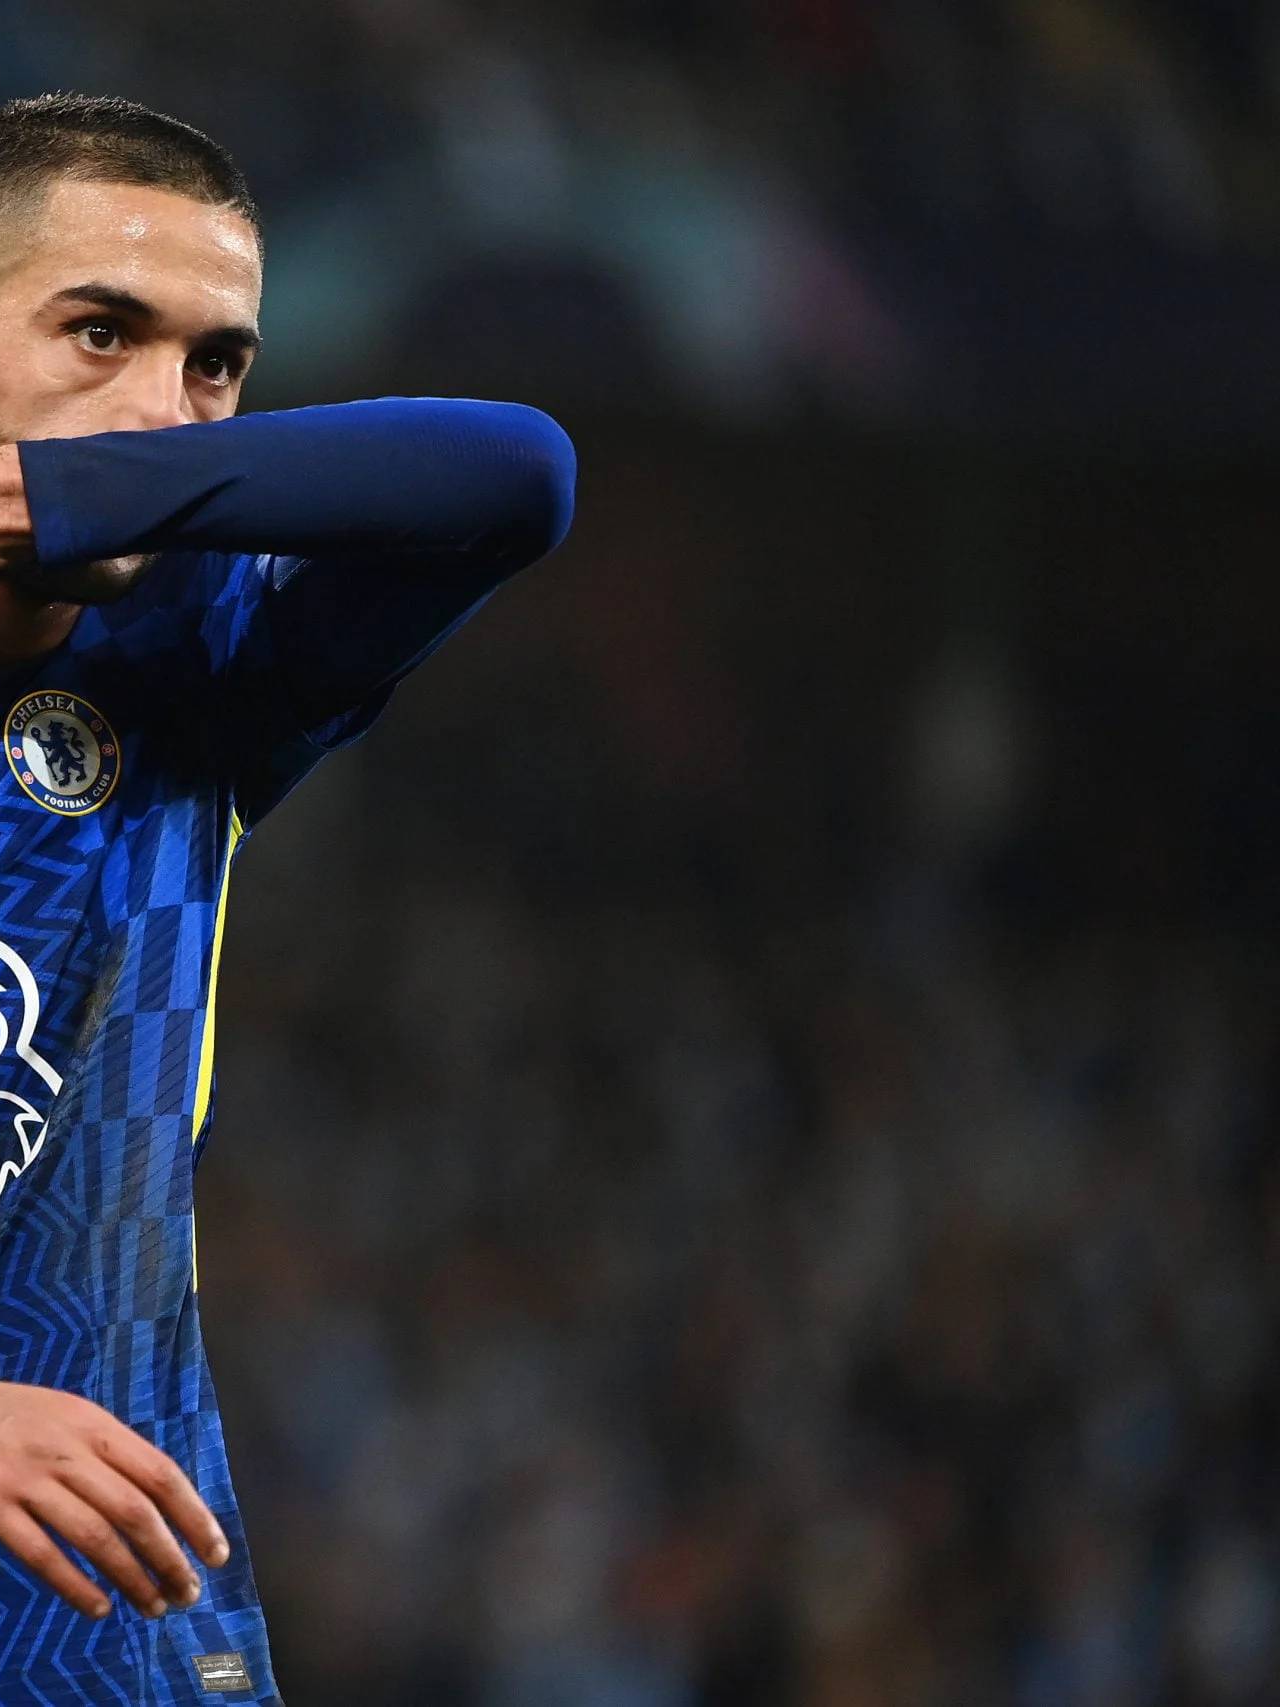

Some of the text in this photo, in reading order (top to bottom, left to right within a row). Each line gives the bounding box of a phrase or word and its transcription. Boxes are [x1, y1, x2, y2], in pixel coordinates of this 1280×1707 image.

[11, 695, 76, 731] CHELSEA
[44, 773, 111, 809] FOOTBALL CLUB
